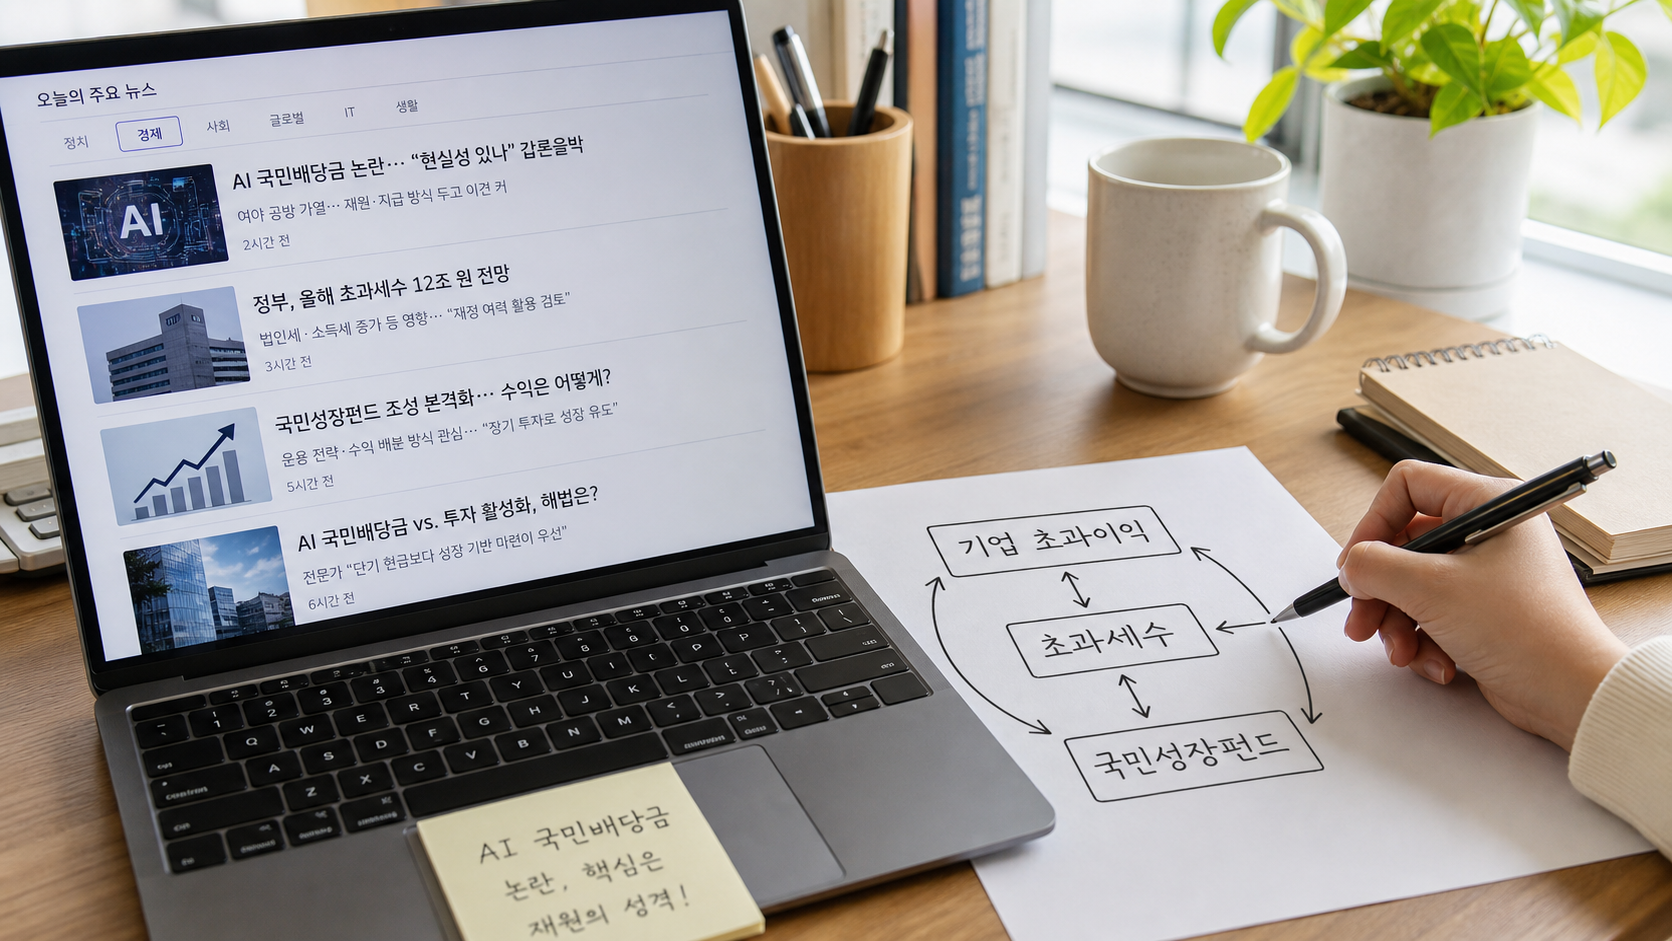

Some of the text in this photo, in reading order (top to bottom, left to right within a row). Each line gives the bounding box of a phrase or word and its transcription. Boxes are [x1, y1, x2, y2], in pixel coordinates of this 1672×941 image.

[37, 82, 158, 108] 오늘의 주요 뉴스
[344, 106, 356, 118] IT
[395, 99, 419, 114] 생활
[137, 126, 163, 143] 경제
[206, 119, 231, 134] 사회
[269, 110, 305, 128] 글로벌
[63, 134, 89, 151] 정치
[232, 172, 252, 191] AI
[256, 161, 346, 189] 국민배당금
[519, 134, 584, 160] 갑론을박
[237, 207, 265, 224] 여야
[268, 203, 296, 222] 공방
[406, 188, 434, 206] 방식
[437, 185, 464, 202] 두고
[465, 181, 492, 198] 이견
[494, 179, 508, 194] 커
[119, 202, 163, 240] AI
[242, 233, 291, 251] 2시간 전
[252, 263, 510, 315] 정부, 올해 초과세수 12조 원 전망
[355, 316, 382, 335] 증가
[385, 314, 399, 331] 등
[482, 299, 508, 317] 여력
[511, 296, 537, 314] 활용
[264, 354, 312, 373] 3시간 전
[274, 403, 382, 435] 국민성장펀드
[385, 395, 420, 418] 조성
[500, 377, 550, 402] 수익은
[554, 368, 611, 393] 어떻게?
[281, 449, 308, 468] 운용
[377, 435, 405, 452] 배분
[407, 430, 434, 449] 방식
[518, 412, 557, 431] 투자로
[560, 406, 585, 424] 성장
[286, 474, 335, 493] 5시간 전
[297, 485, 599, 553] AI 국민배당금 vs. 투자 활성화, 해법은?
[957, 519, 1151, 558] 기업 초과이익
[302, 564, 343, 586] 전문가
[438, 543, 464, 562] 성장
[467, 537, 493, 555] 기반
[495, 530, 534, 550] 마련이
[308, 591, 356, 611] 6시간 전
[1041, 621, 1175, 658] 초과세수
[245, 737, 258, 746] Q
[299, 725, 314, 735] W
[356, 714, 367, 723] E
[408, 703, 420, 712] R
[459, 691, 470, 700] T
[511, 680, 521, 689] Y
[562, 670, 574, 679] U
[268, 763, 281, 773] A
[323, 751, 335, 761] S
[375, 739, 388, 749] D
[478, 717, 490, 726] G
[528, 705, 541, 715] H
[581, 695, 589, 704] J
[627, 684, 640, 694] K
[676, 675, 688, 683] L
[305, 786, 317, 798] Z
[359, 774, 372, 785] X
[413, 762, 426, 772] C
[465, 750, 476, 760] V
[517, 739, 530, 749] B
[567, 727, 581, 737] N
[617, 716, 632, 726] M
[1093, 732, 1290, 780] 국민성장펀드
[479, 805, 670, 865] AI 국민배당금
[504, 871, 568, 902] 논란,
[624, 884, 689, 918] 성격!
